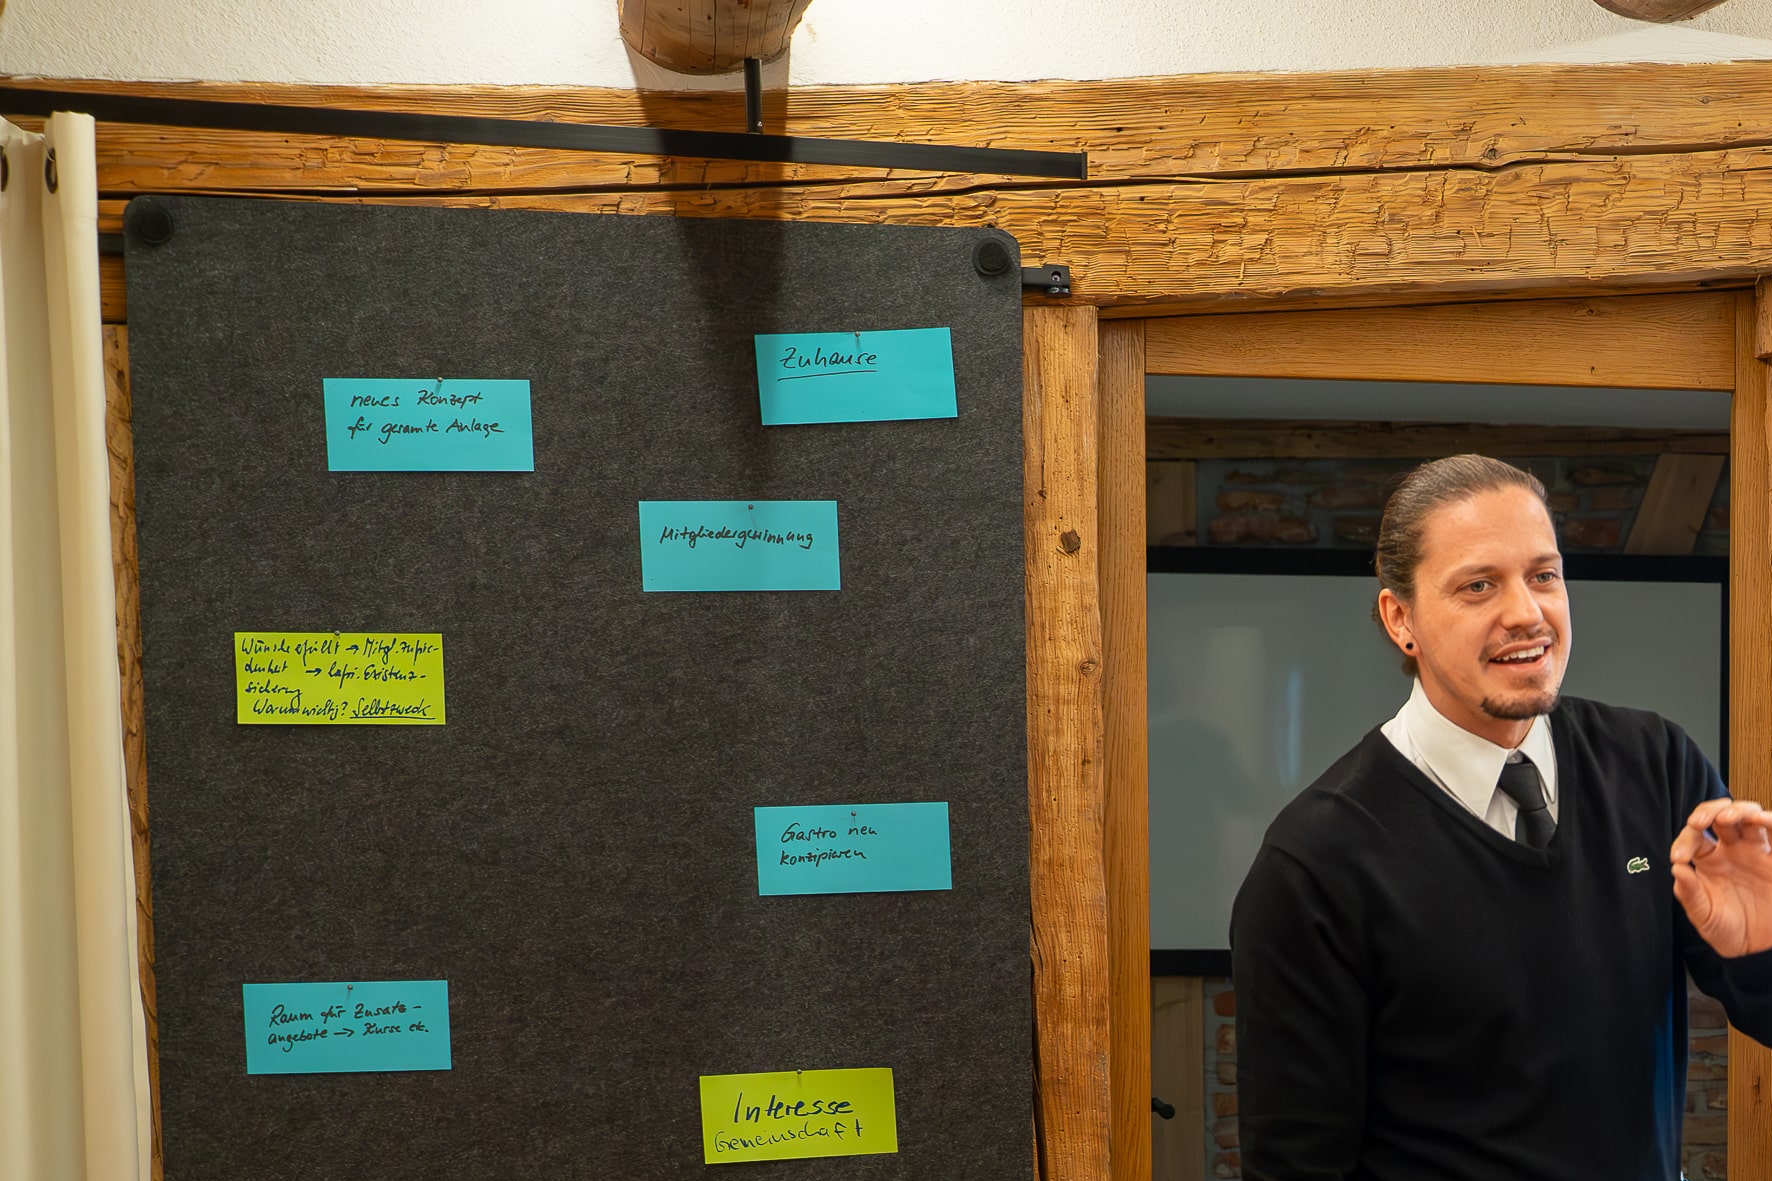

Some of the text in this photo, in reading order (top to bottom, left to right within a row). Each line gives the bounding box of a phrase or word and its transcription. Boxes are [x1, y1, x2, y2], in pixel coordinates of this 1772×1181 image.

[779, 347, 877, 369] Zuhause
[350, 389, 483, 409] neues Konzept
[347, 416, 504, 444] für gesamte Anlage
[659, 525, 813, 549] Mitgliedergewinnung
[780, 822, 877, 843] Gastro neu
[780, 848, 867, 867] konzipieren
[269, 1004, 313, 1027] Raum
[320, 1005, 346, 1024] für
[268, 1029, 328, 1052] angebote
[734, 1092, 853, 1123] Interesse
[715, 1119, 863, 1152] Gemeinschaft
